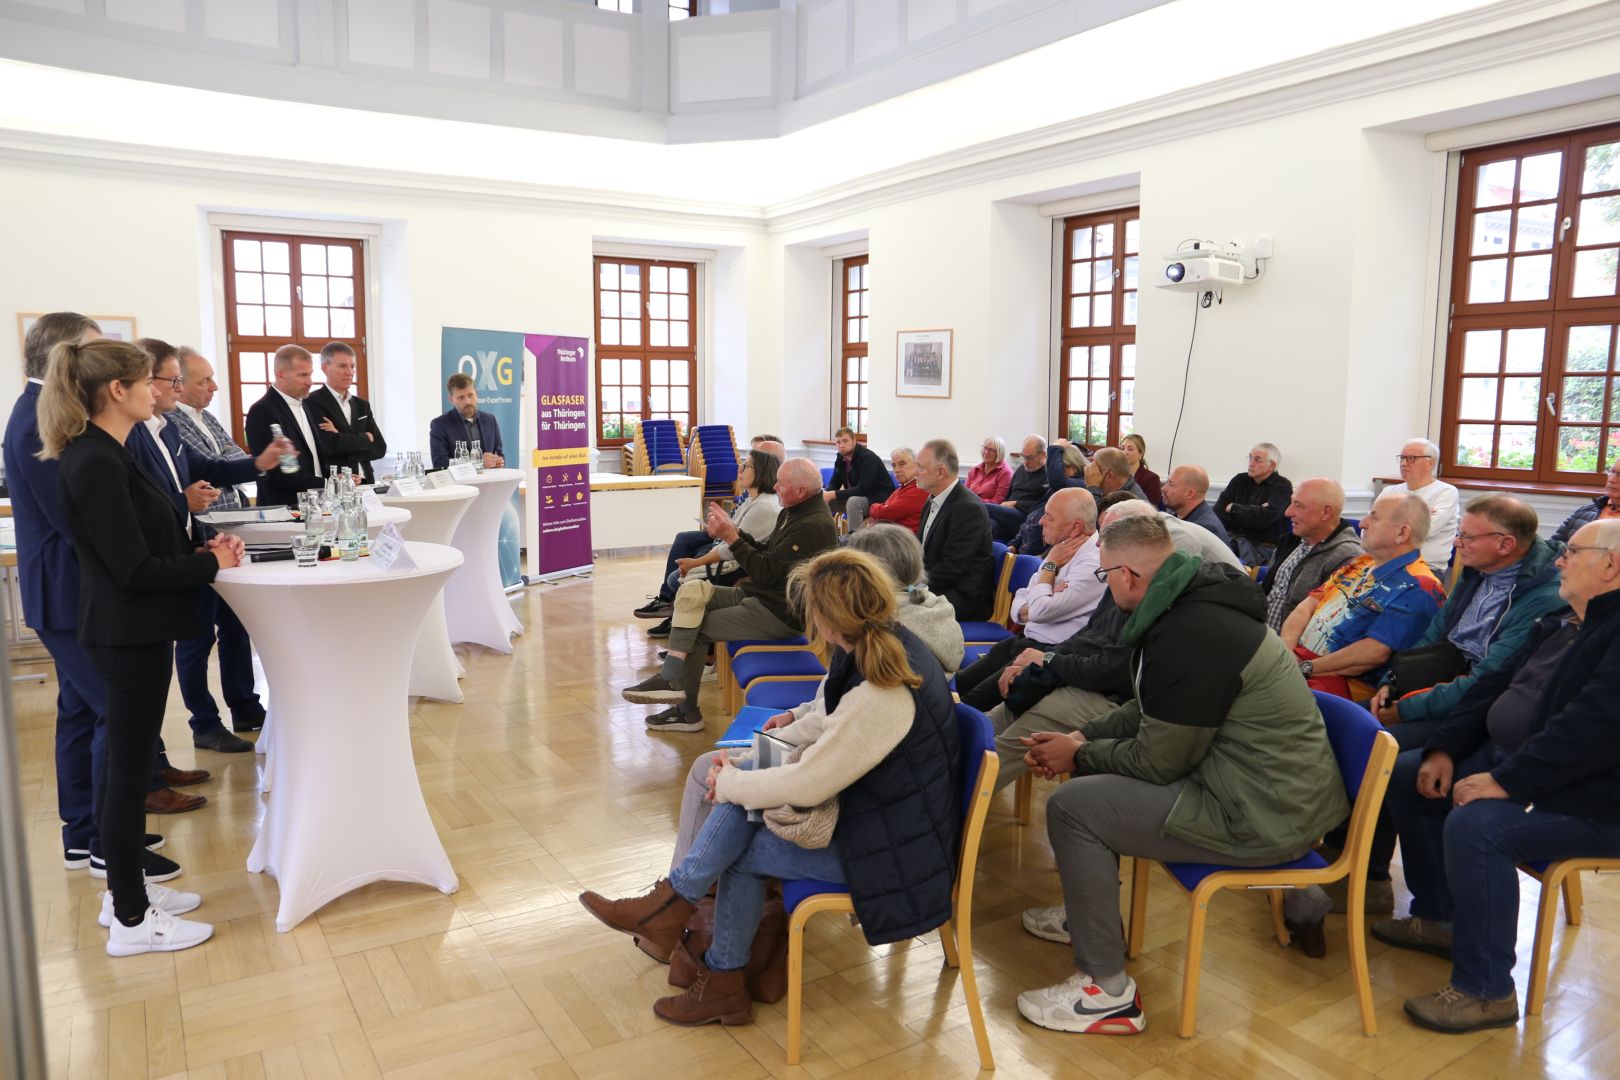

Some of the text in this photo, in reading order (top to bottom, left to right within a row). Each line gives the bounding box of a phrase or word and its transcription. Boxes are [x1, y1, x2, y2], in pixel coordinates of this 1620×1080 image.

[557, 348, 576, 357] Thüringer
[458, 350, 513, 391] OXG
[541, 394, 585, 406] GLASFASER
[541, 408, 586, 419] aus Thüringen
[541, 420, 586, 432] für Thüringen
